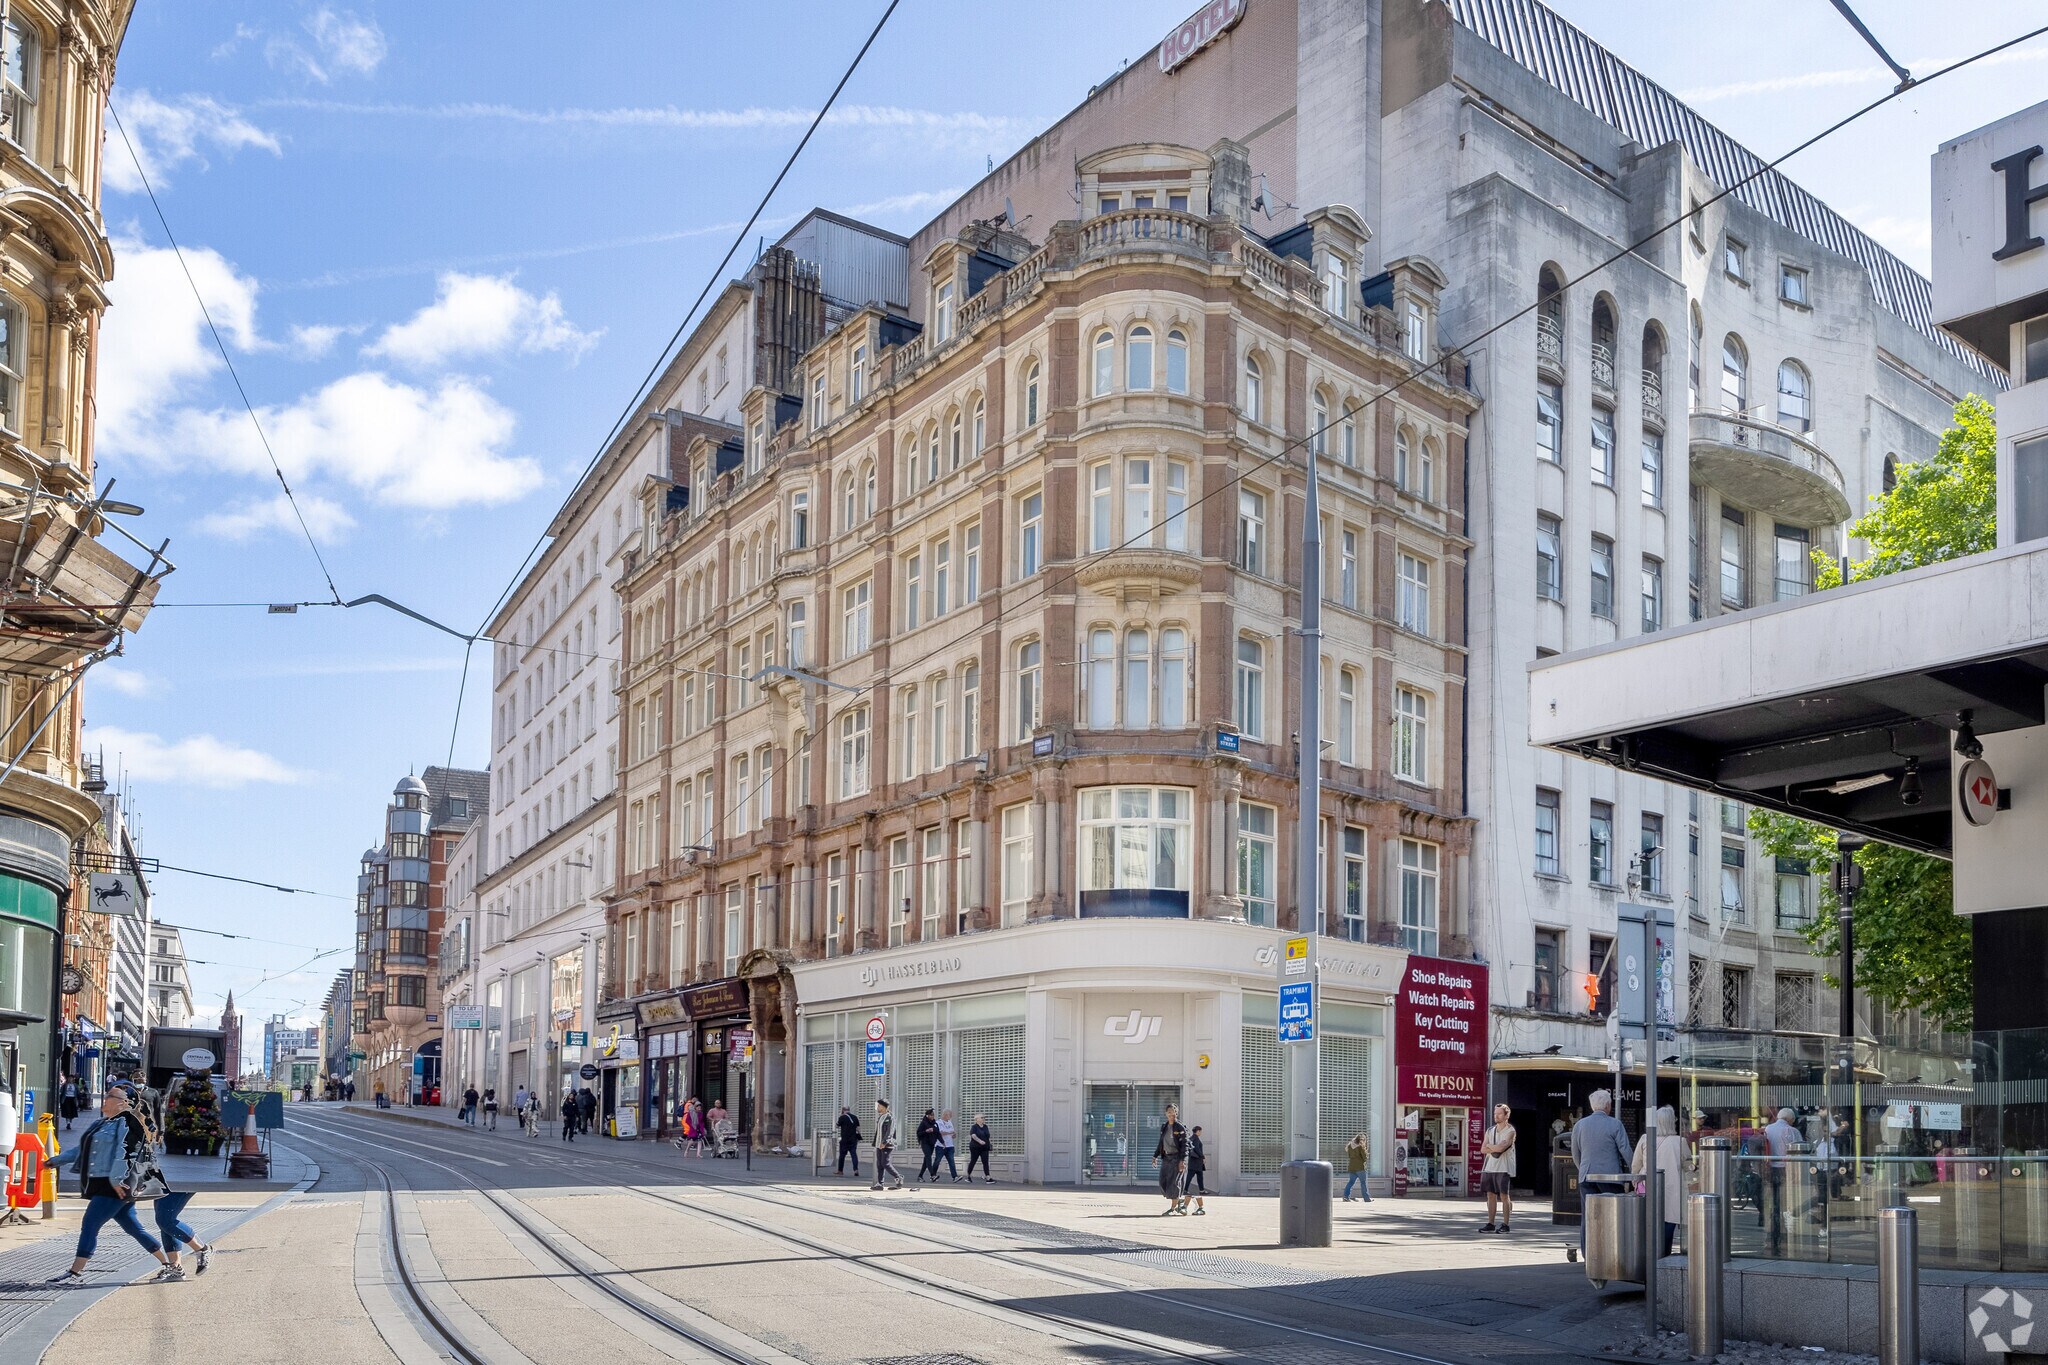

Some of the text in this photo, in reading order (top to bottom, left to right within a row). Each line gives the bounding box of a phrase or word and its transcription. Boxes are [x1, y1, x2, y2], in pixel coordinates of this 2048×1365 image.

[1162, 0, 1237, 68] HOTEL
[888, 958, 962, 980] HASSELBLAD
[1318, 957, 1382, 978] SELBLAD
[1412, 969, 1472, 989] Shoe Repairs
[1283, 987, 1309, 996] TRAMWAY
[1409, 990, 1475, 1011] Watch Repairs
[1415, 1012, 1469, 1034] Key Cutting
[1419, 1035, 1465, 1054] Engraving
[1414, 1074, 1474, 1091] TIMPSON
